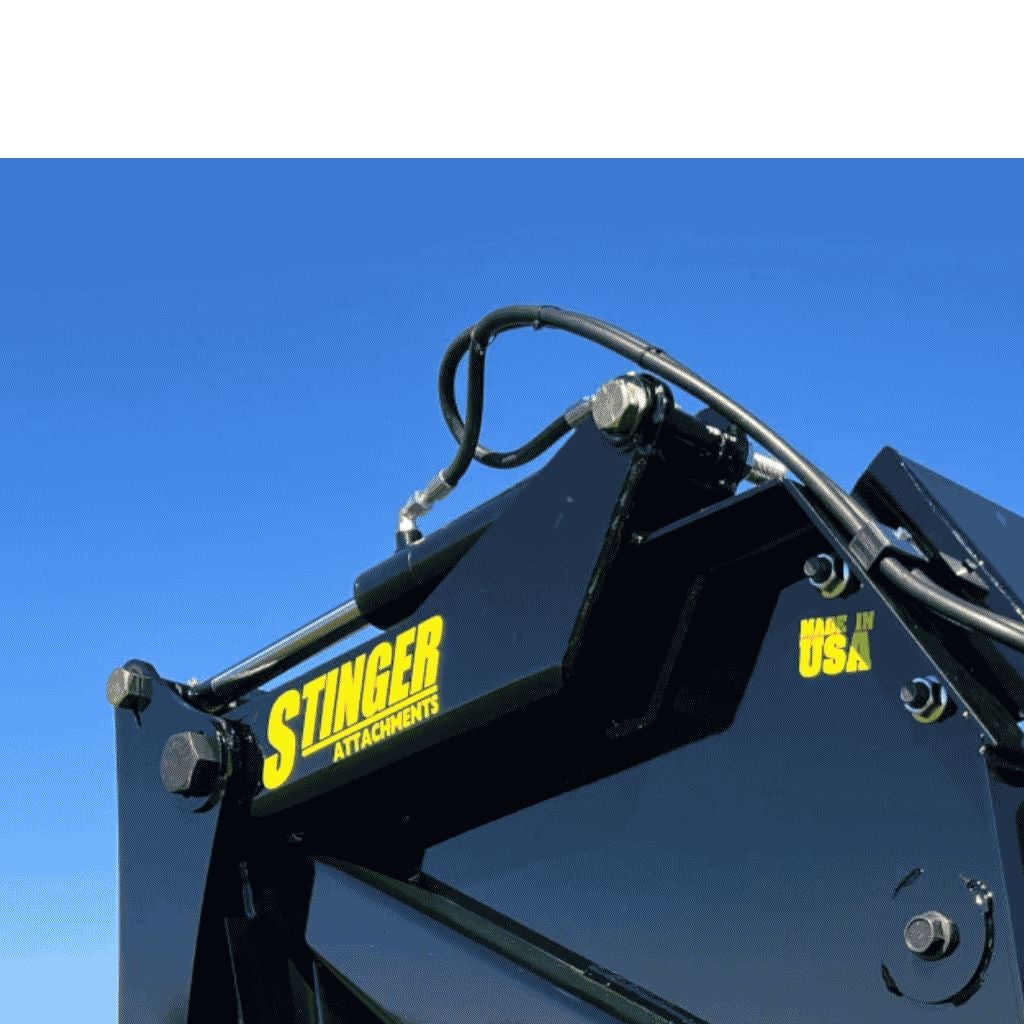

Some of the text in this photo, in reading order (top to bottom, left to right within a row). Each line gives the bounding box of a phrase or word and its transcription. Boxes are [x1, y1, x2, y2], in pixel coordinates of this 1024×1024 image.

[800, 610, 875, 636] MADE IN
[798, 631, 872, 678] USA
[262, 614, 444, 790] STINGER
[332, 694, 440, 763] ATTACHMENTS
